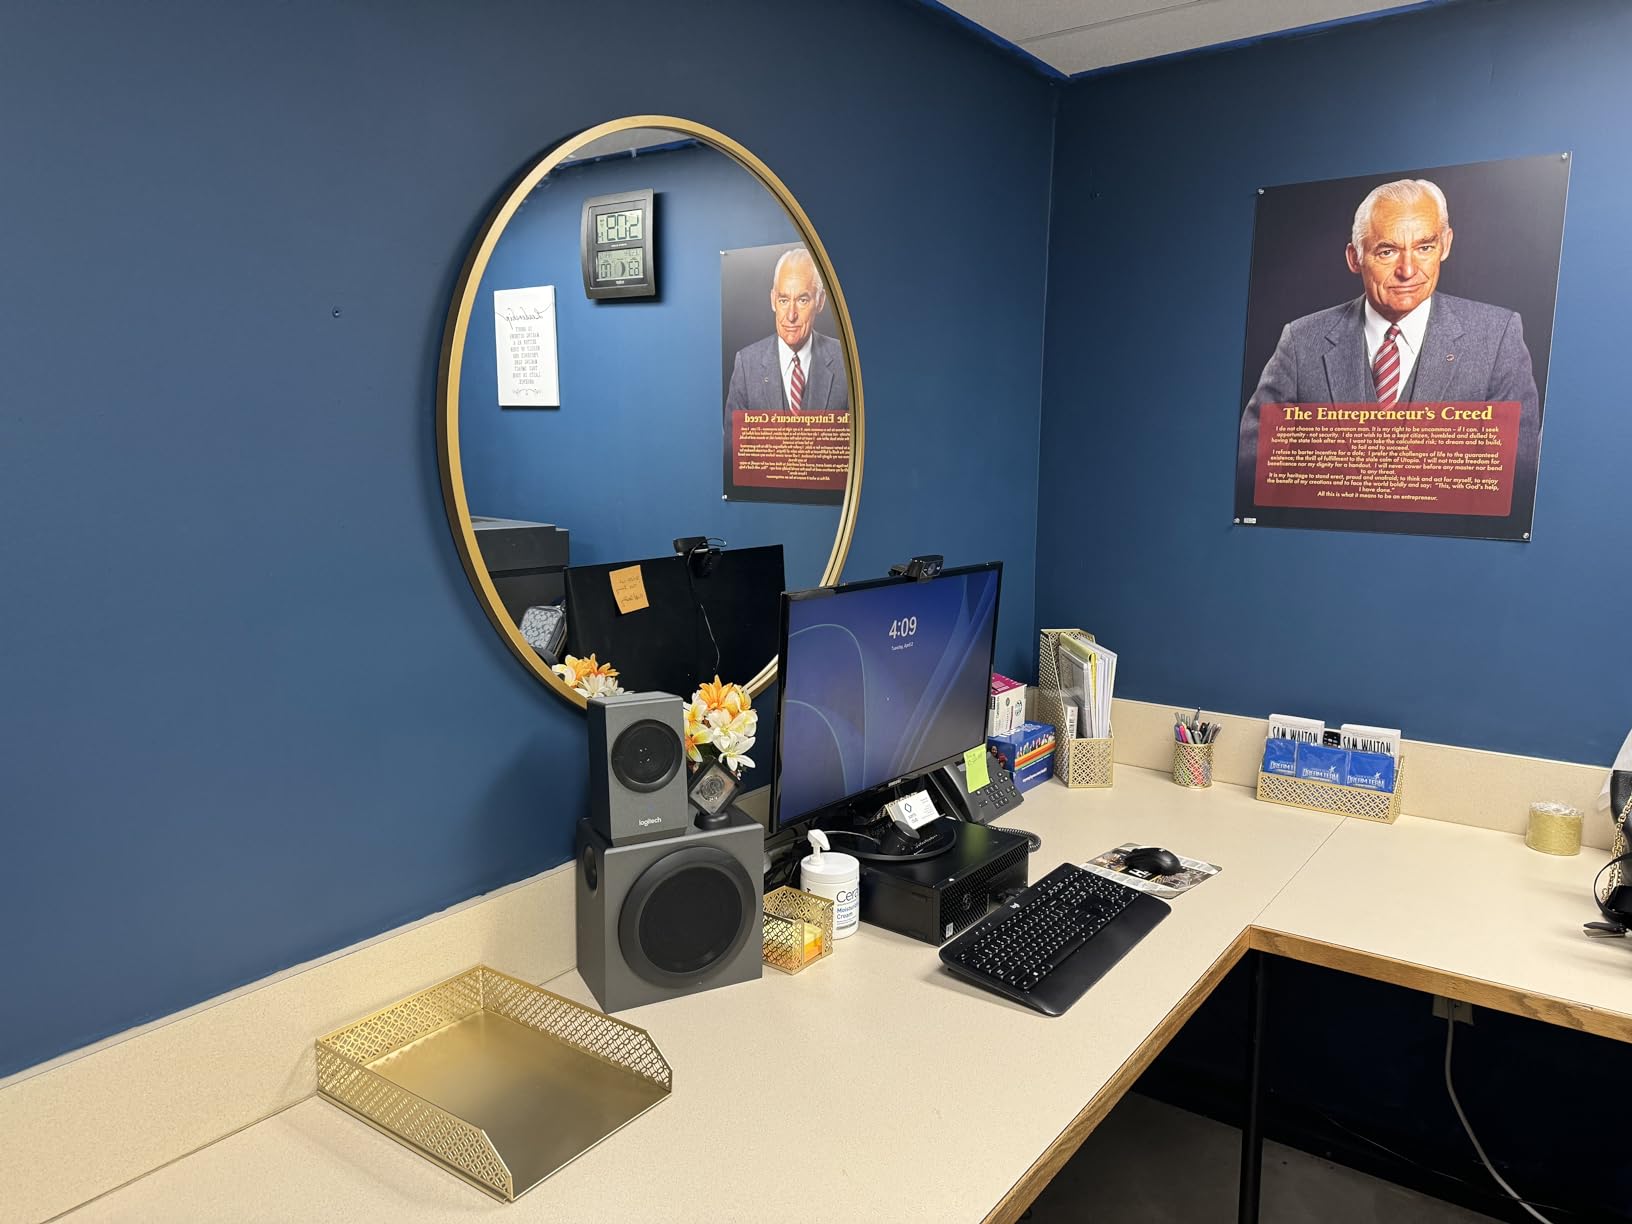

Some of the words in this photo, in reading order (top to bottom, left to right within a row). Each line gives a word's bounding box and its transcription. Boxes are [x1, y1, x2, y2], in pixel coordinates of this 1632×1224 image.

[1283, 407, 1312, 420] The
[1317, 408, 1435, 423] Entrepreneur's
[1441, 406, 1493, 420] Creed
[888, 616, 917, 639] 4:09
[1272, 726, 1286, 739] SAM
[1290, 729, 1318, 744] WALTON
[1343, 736, 1357, 750] SAM
[1362, 739, 1391, 754] WALTON
[639, 816, 662, 827] logitech
[837, 912, 853, 920] Cream
